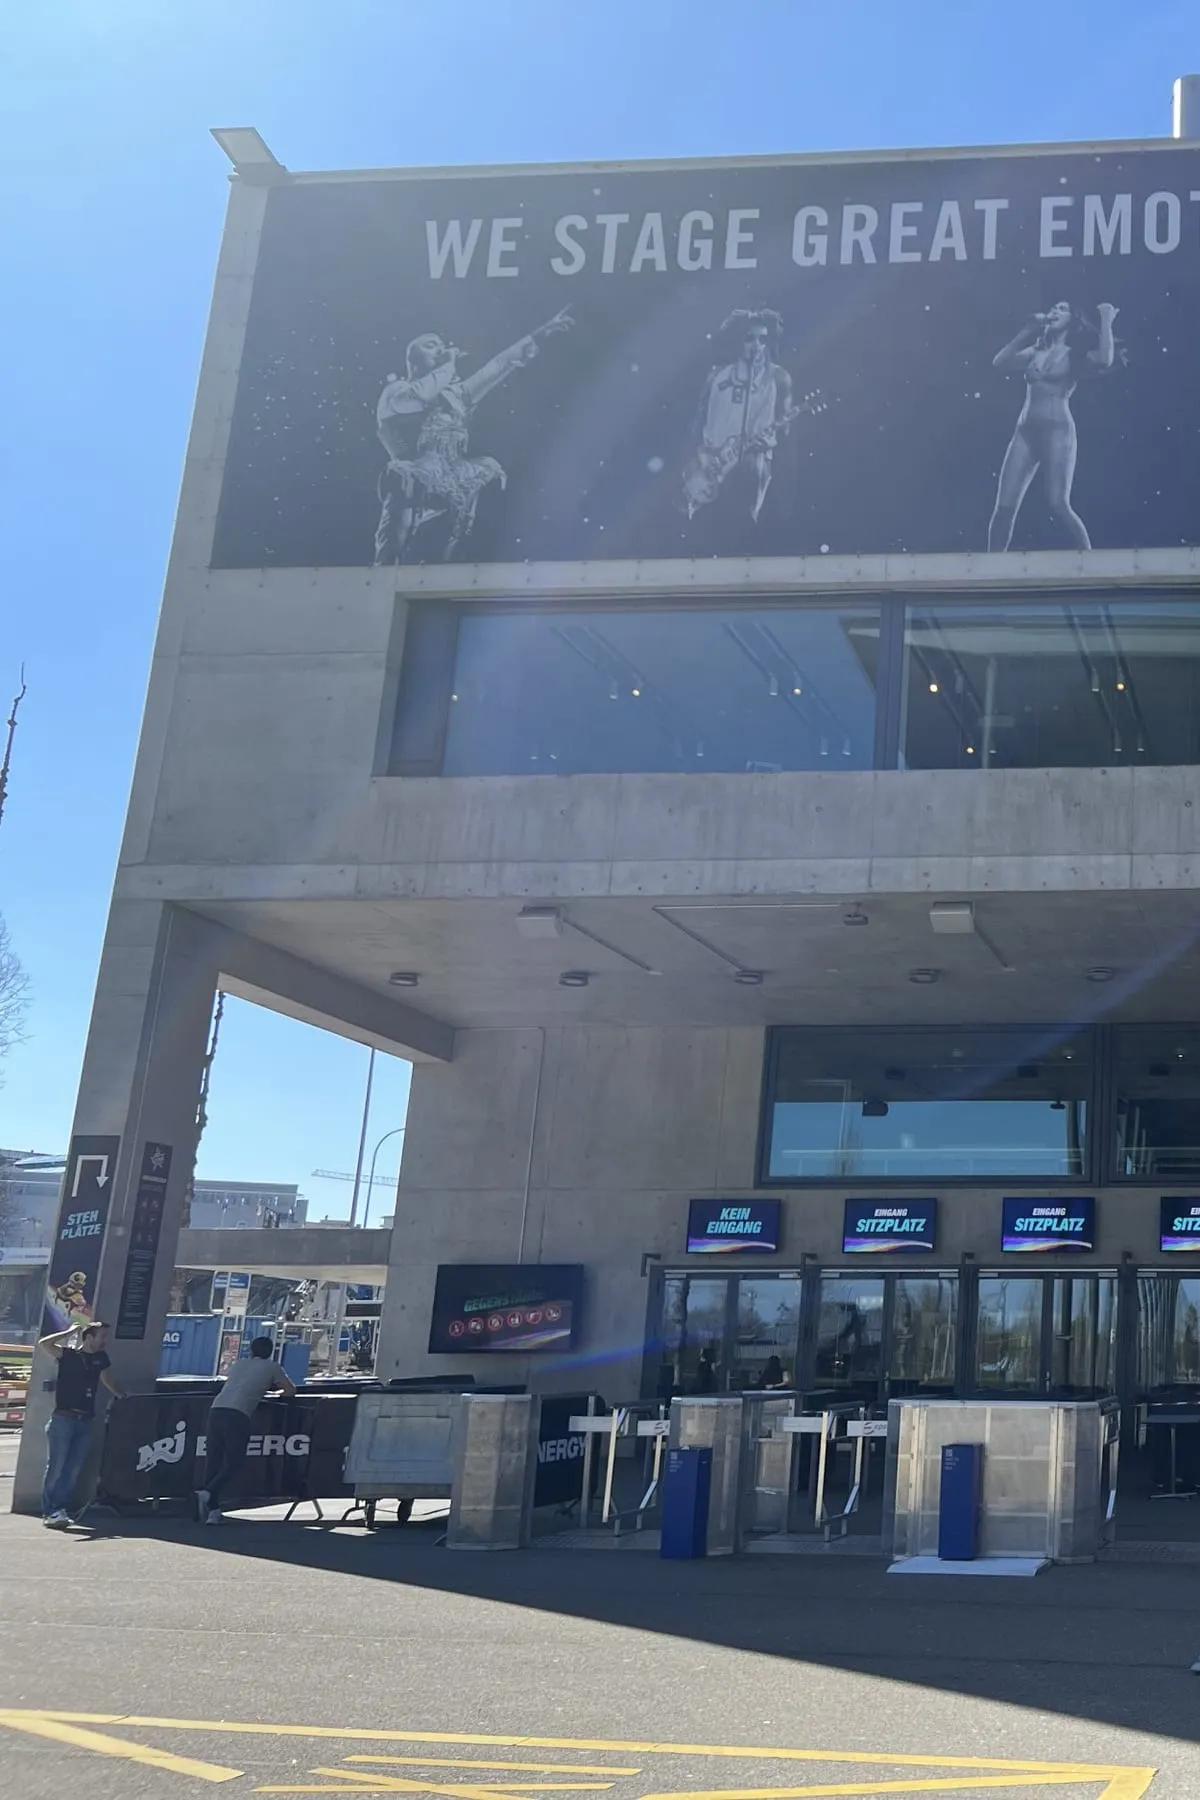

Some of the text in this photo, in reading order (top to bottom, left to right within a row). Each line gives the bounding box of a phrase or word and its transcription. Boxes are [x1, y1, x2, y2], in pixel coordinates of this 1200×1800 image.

[425, 217, 523, 280] WE
[549, 208, 761, 276] STAGE
[791, 198, 1010, 267] GREAT
[66, 1209, 99, 1226] STEH
[719, 1207, 752, 1221] KEIN
[874, 1208, 908, 1218] EINGANG
[1032, 1207, 1067, 1217] EINGANG
[706, 1220, 762, 1234] EINGANG
[855, 1218, 927, 1233] SITZPLATZ
[1014, 1217, 1085, 1232] SITZPLATZ
[538, 1436, 588, 1464] NERGY
